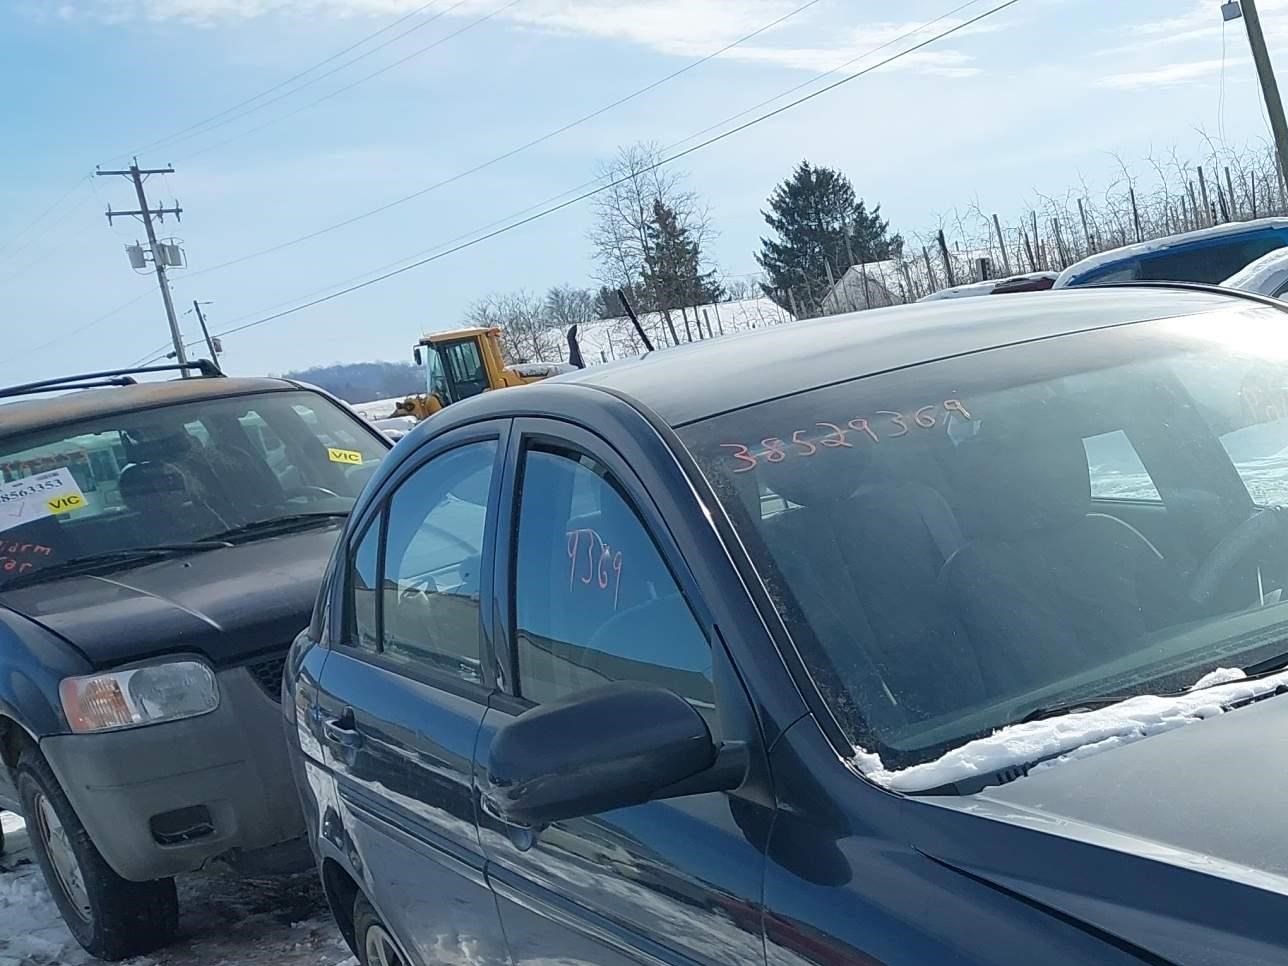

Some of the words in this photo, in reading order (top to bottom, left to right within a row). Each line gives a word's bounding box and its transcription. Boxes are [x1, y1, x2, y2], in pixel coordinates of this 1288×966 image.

[719, 400, 970, 473] 38529369
[331, 451, 359, 462] VIC
[0, 479, 63, 503] 8563353
[48, 495, 81, 509] VIC
